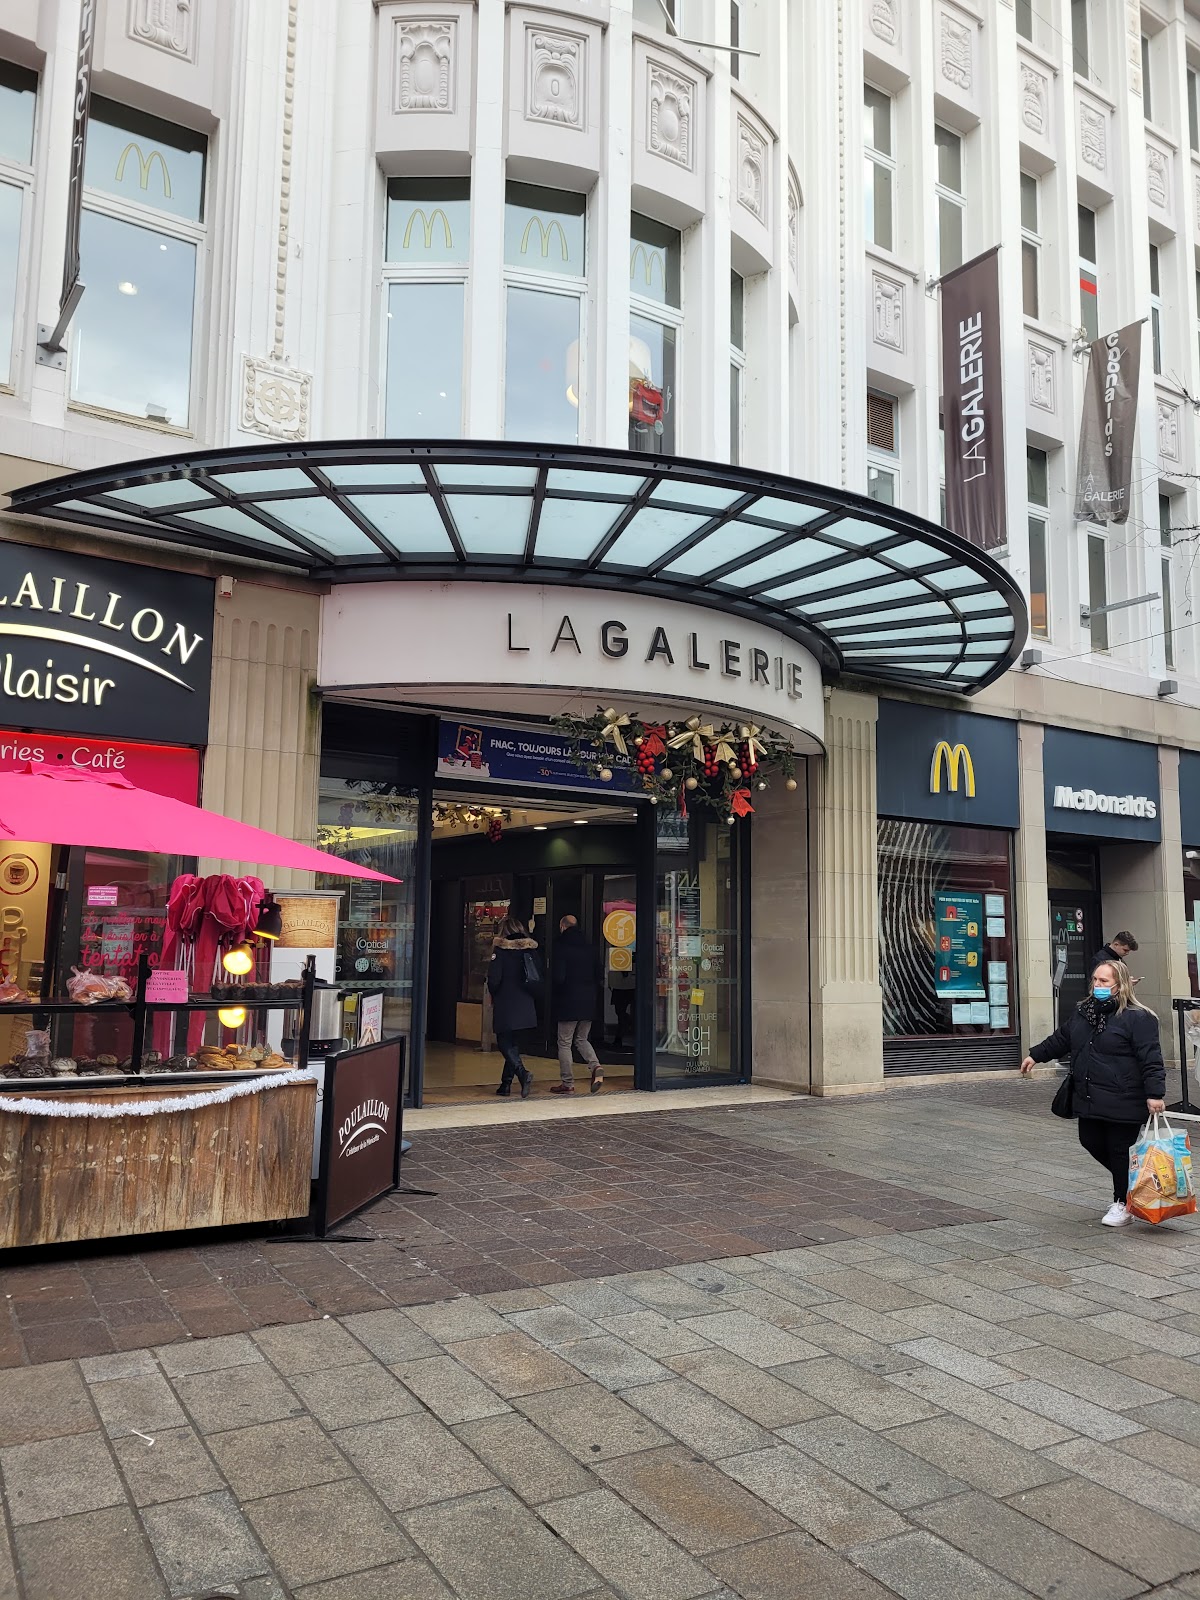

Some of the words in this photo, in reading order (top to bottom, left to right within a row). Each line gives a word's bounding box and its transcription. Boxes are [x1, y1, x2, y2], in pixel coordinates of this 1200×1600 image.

[1105, 332, 1121, 457] cDonald's
[1084, 488, 1125, 502] GALERIE
[0, 653, 116, 706] laisir
[71, 747, 126, 769] Café
[490, 739, 517, 752] FNAC,
[518, 742, 562, 756] TOUJOURS
[577, 750, 597, 761] OUR
[1053, 785, 1157, 819] McDonald's
[145, 916, 168, 929] moy
[283, 919, 331, 932] OULAILLON
[357, 938, 389, 950] Optical
[80, 943, 161, 967] tentato
[678, 1012, 718, 1022] OUVERTURE
[685, 1026, 710, 1041] 10H
[685, 1041, 710, 1057] 19H
[338, 1099, 390, 1146] POULAILLON
